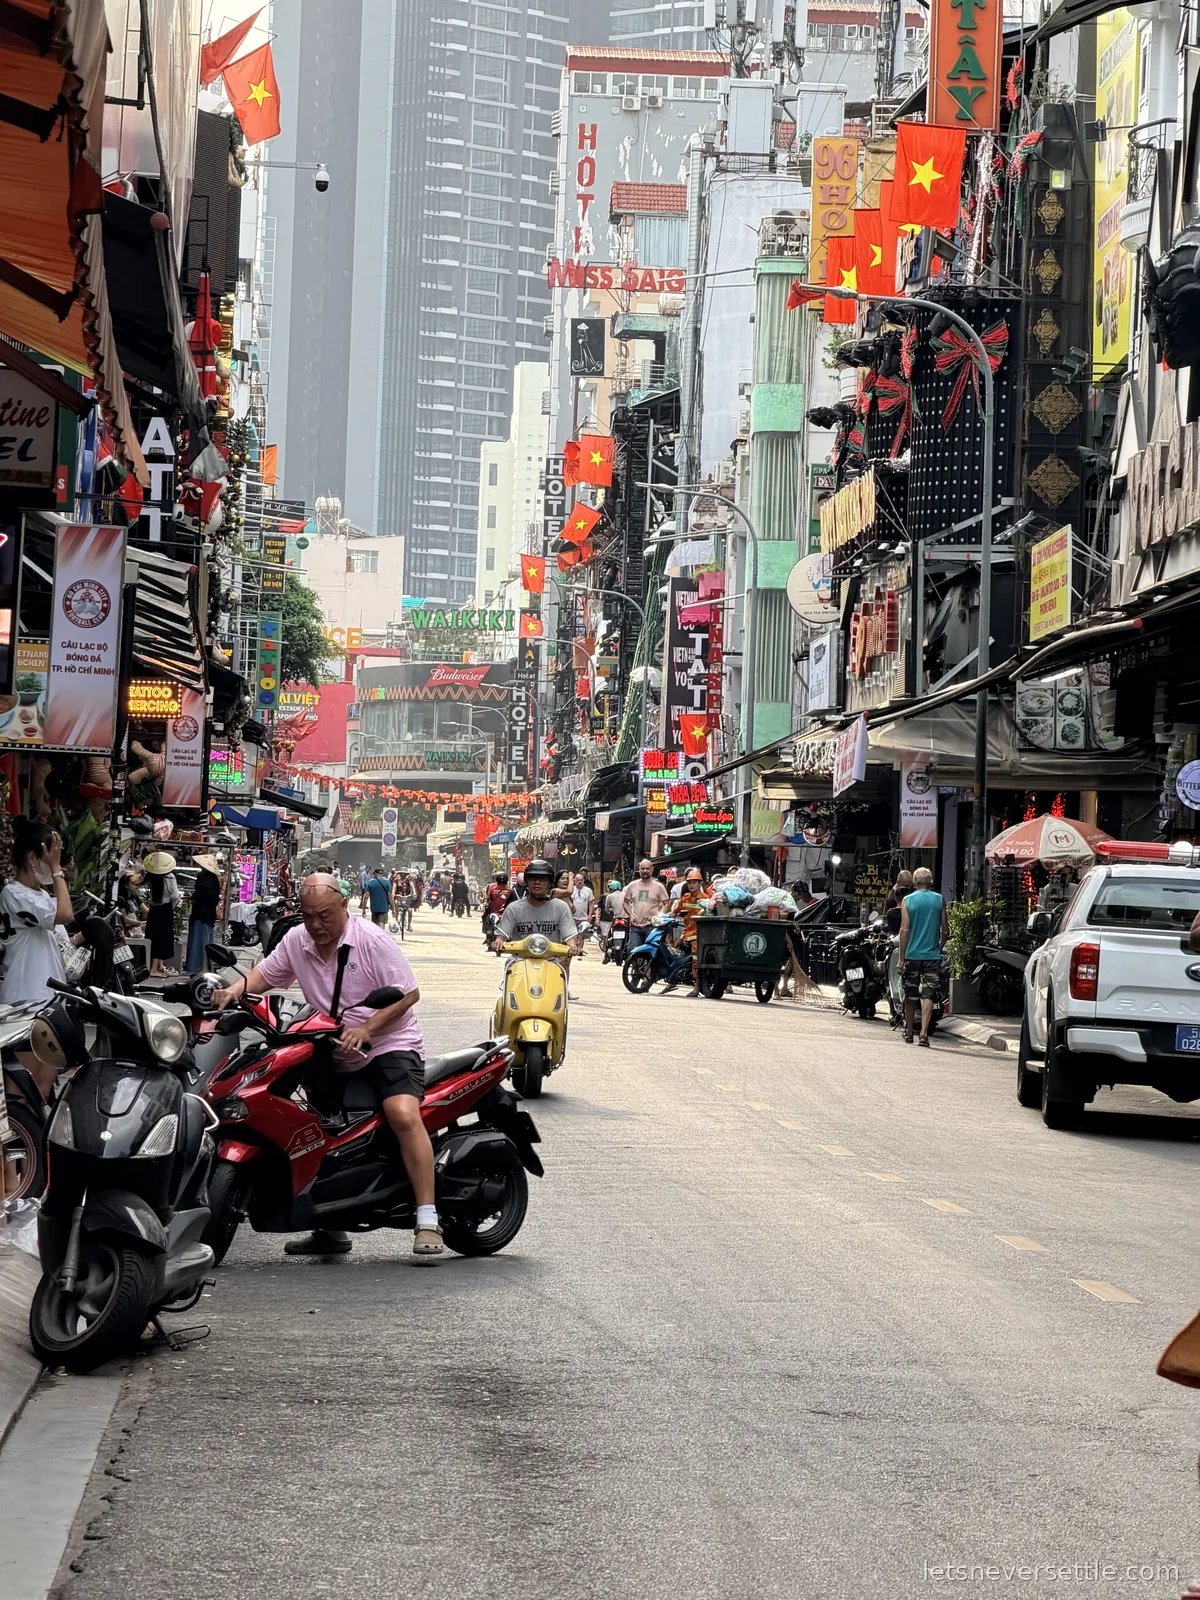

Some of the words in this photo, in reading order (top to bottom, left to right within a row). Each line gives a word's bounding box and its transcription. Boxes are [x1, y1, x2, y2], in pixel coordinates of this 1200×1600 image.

[816, 144, 855, 180] 96
[546, 459, 564, 557] HOTEL
[84, 582, 99, 592] MINH
[411, 609, 515, 632] WAIKIKI
[61, 640, 78, 650] CÂU
[80, 643, 96, 652] LẠC
[97, 644, 108, 652] BỘ
[66, 653, 88, 662] BÓNG
[90, 654, 102, 662] ĐÁ
[260, 623, 278, 704] TATTOO
[52, 664, 62, 673] TP.
[65, 664, 76, 674] HỒ
[78, 666, 92, 674] CHÍ
[94, 668, 115, 676] MINH
[430, 668, 484, 680] Budweiser
[129, 686, 172, 698] TATTOO
[512, 687, 526, 780] HOTEL
[426, 752, 474, 762] WAIKIKI
[517, 924, 534, 932] NEW
[536, 924, 558, 932] YORK
